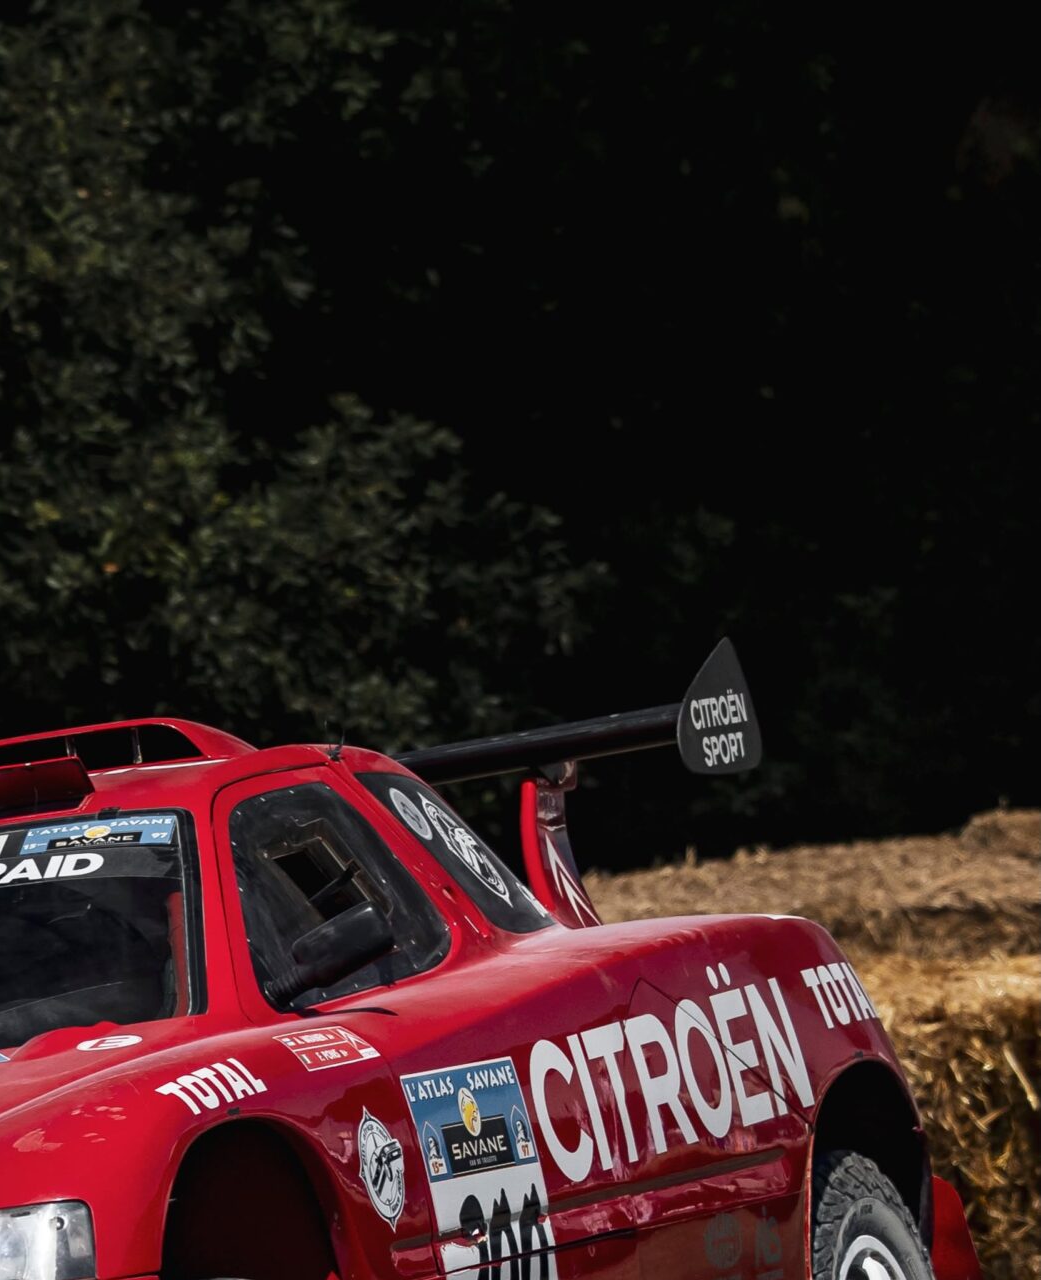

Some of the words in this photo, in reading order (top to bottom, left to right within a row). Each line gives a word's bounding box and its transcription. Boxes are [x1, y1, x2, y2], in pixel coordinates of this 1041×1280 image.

[690, 688, 748, 730] CITROËN
[702, 731, 745, 767] SPORT
[109, 818, 173, 827] SAVANE
[800, 962, 877, 1029] TOTA
[155, 1058, 268, 1115] TOTAL
[405, 1076, 455, 1102] L'ATLAS
[466, 1065, 515, 1091] SAVANE
[530, 962, 816, 1183] CITROËN
[451, 1135, 507, 1160] SAVANE
